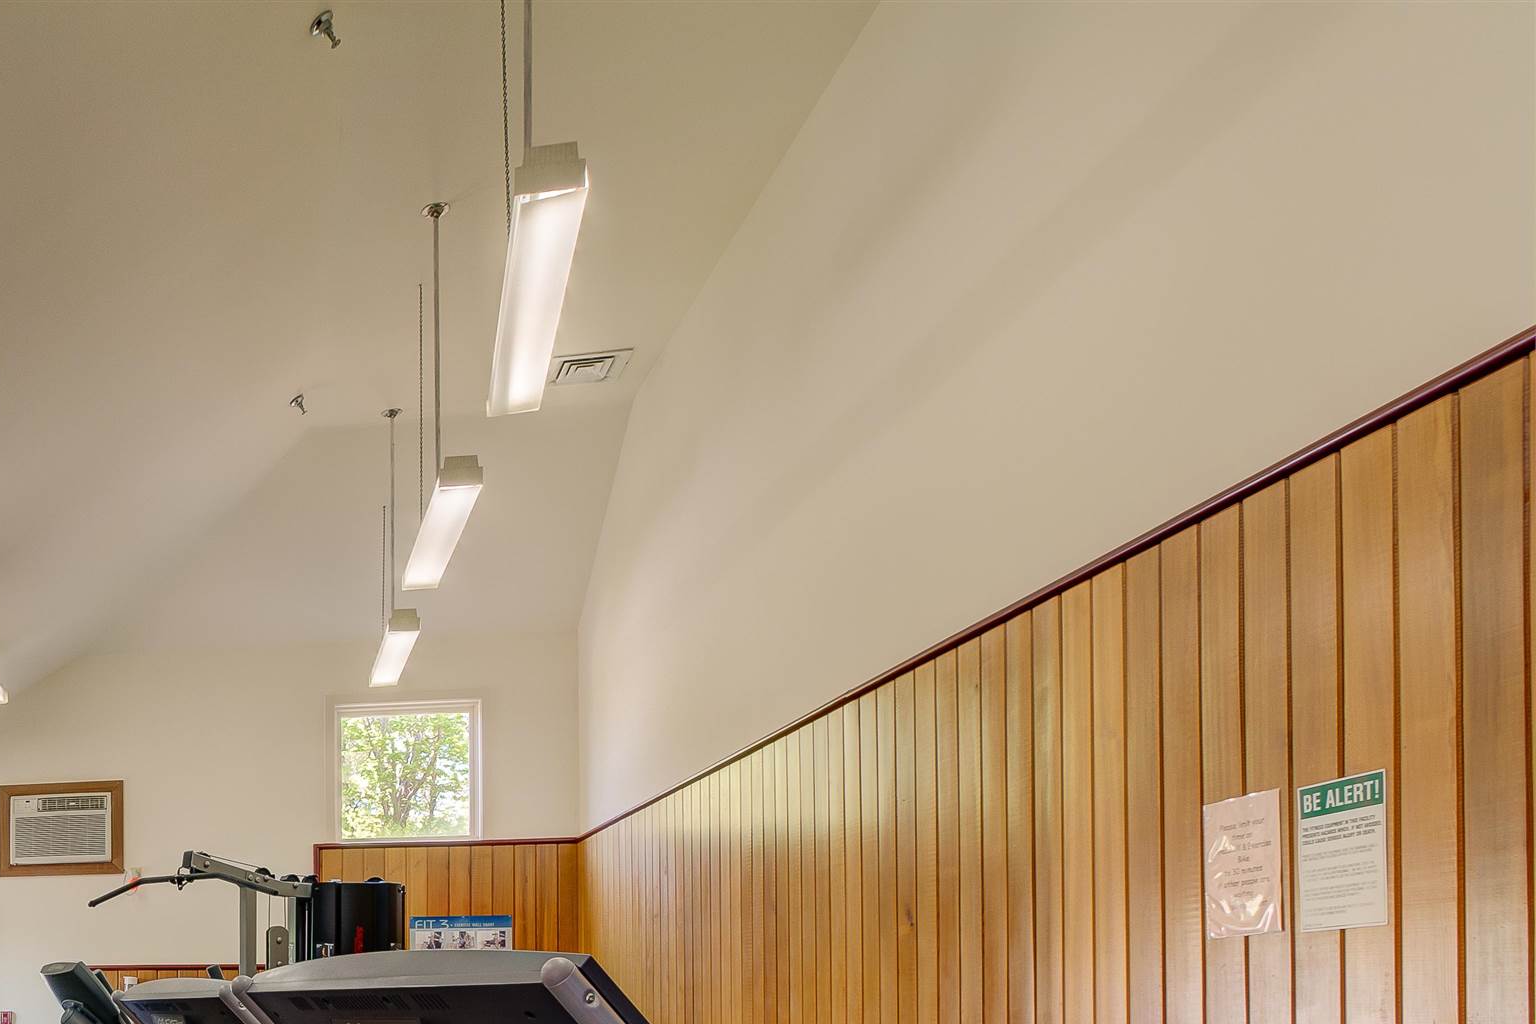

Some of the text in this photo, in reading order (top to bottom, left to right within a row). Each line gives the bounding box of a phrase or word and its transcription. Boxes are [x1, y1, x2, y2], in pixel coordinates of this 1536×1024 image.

[1303, 779, 1380, 814] BE ALERT!
[415, 919, 436, 929] FIT
[440, 919, 450, 929] 3
